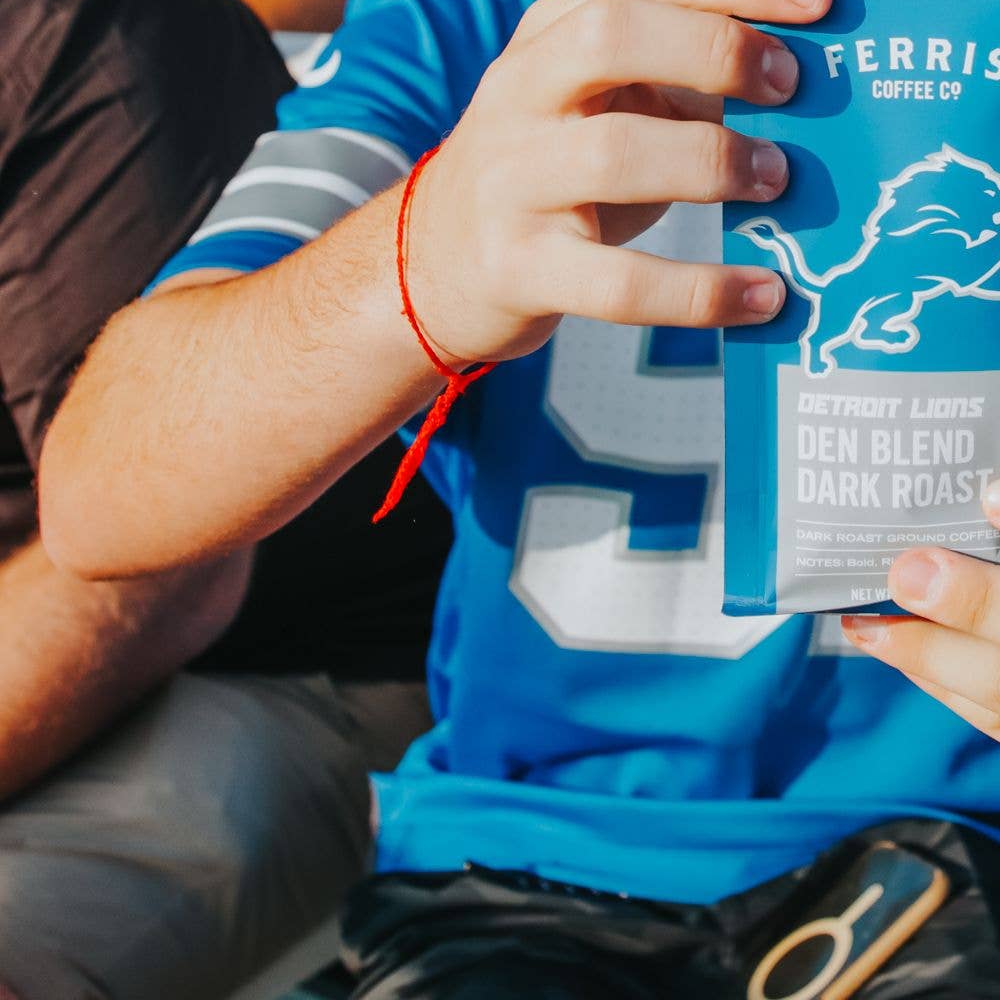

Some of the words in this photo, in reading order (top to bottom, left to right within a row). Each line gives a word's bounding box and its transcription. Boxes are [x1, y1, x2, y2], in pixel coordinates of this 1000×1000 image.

[872, 80, 935, 100] COFFEE
[797, 392, 903, 419] DETROIT
[909, 396, 985, 419] LIONS
[797, 424, 858, 465] DEN
[870, 428, 975, 466] BLEND
[796, 467, 882, 508] DARK
[891, 467, 994, 509] ROAST
[796, 529, 833, 543] DARK
[836, 532, 883, 544] ROAST
[887, 531, 946, 543] GROUND
[949, 529, 1000, 543] COFFEE
[796, 557, 845, 568] NOTES:
[850, 587, 872, 601] NET
